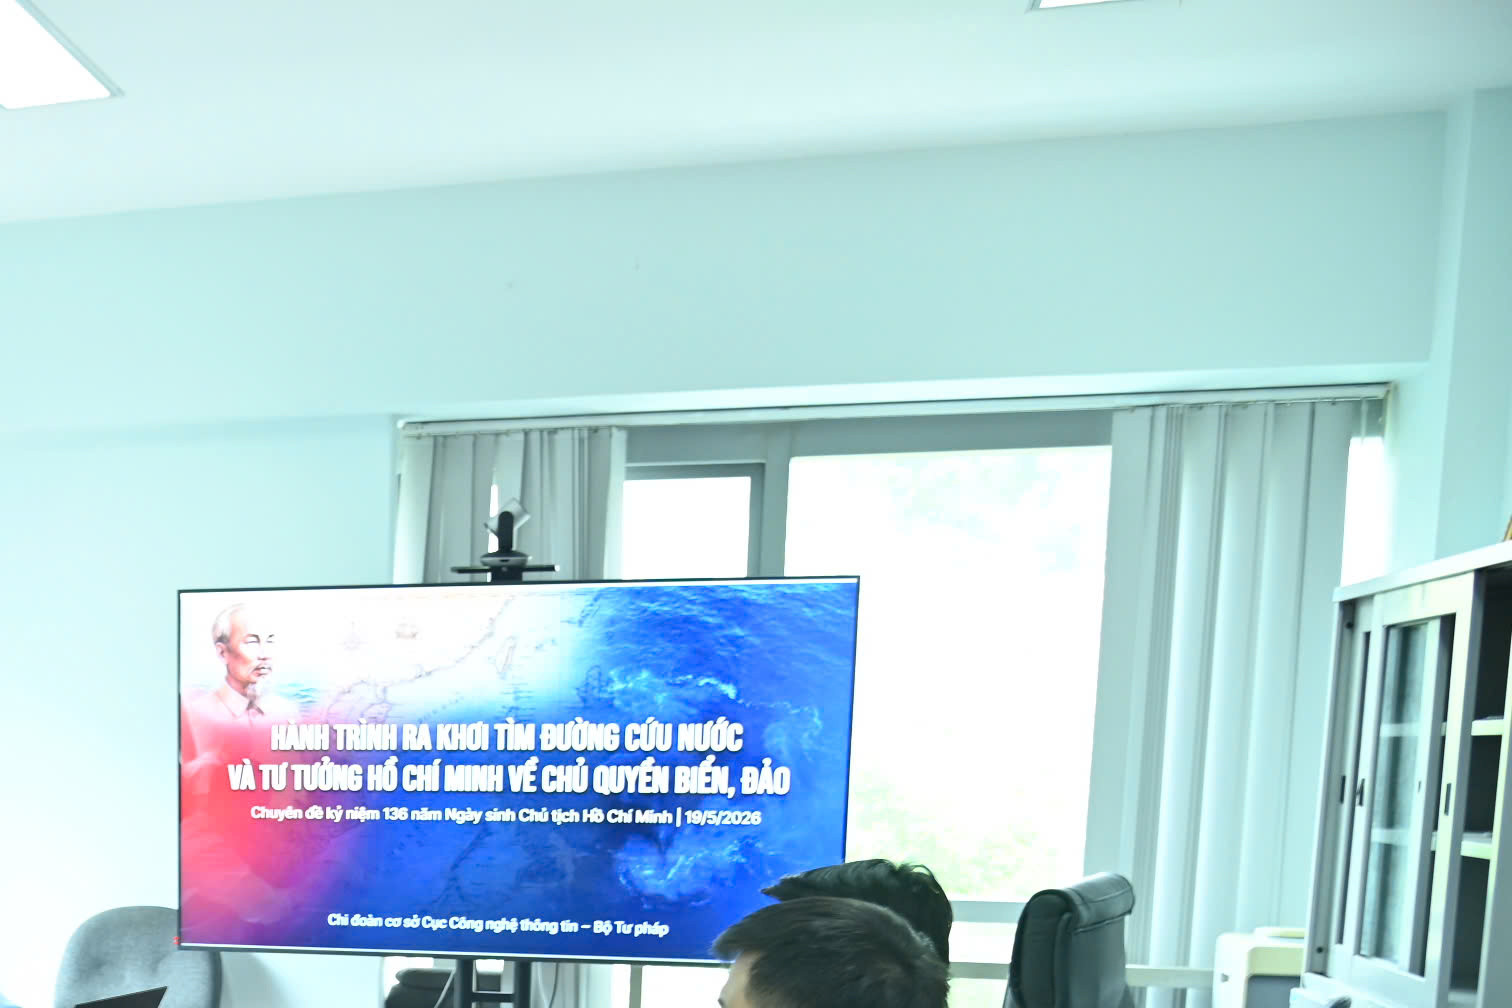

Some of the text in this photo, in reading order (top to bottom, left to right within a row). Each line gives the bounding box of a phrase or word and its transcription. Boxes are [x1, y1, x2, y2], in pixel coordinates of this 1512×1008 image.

[271, 716, 744, 752] HÀNH TRÌNH RA KHƠI TÌM ĐƯỜNG CỨU NƯỚC
[227, 754, 791, 799] VÀ TƯ TƯỞNG HỒ CHÍ MINH VỀ CHỦ QUYỀN BIỂN, ĐẢO
[251, 805, 303, 822] Chuyên
[305, 805, 324, 820] đề
[346, 806, 380, 823] niệm
[382, 807, 408, 821] 136
[411, 806, 442, 821] năm
[444, 807, 483, 825] Ngày
[485, 808, 516, 822] sinh
[518, 807, 549, 823] Chủ
[551, 808, 580, 826] tịch
[582, 807, 605, 823] Hồ
[606, 809, 633, 824] Chí
[635, 809, 673, 825] Minh
[685, 810, 762, 826] 19/5/2026
[327, 913, 349, 926] Chi
[350, 913, 383, 927] đoàn
[384, 916, 402, 928] cơ
[403, 914, 420, 928] sở
[421, 915, 448, 931] Cục
[448, 915, 484, 933] Công
[485, 917, 518, 934] nghệ
[519, 918, 559, 935] thông
[560, 919, 579, 933] tin
[593, 919, 613, 936] Bộ
[613, 920, 634, 934] Tư
[634, 921, 670, 938] pháp
